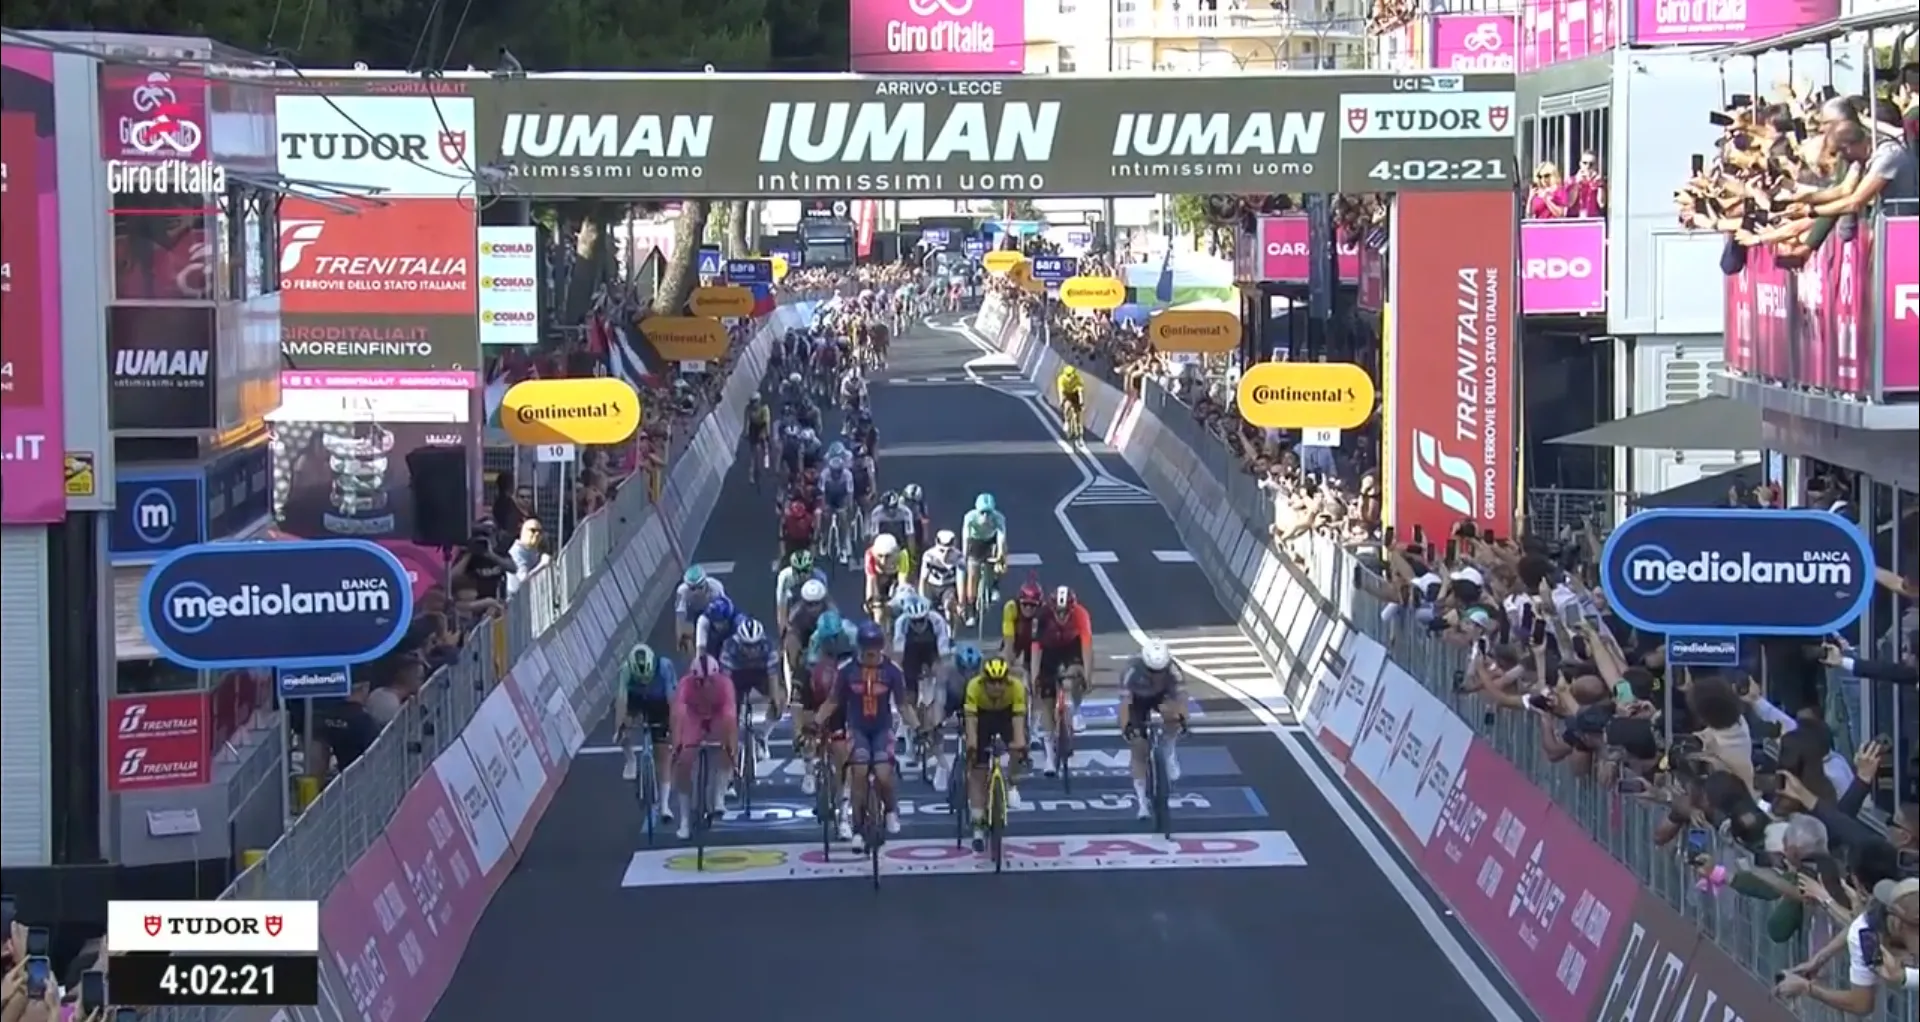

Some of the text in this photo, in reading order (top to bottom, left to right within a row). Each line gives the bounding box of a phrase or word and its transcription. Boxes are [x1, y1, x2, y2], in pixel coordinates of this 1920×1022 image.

[888, 20, 994, 52] Giro d'Italia
[876, 81, 938, 95] ARRIVO
[949, 81, 1002, 95] LECCE
[1393, 78, 1418, 90] UCI
[1375, 109, 1481, 130] TUDOR
[502, 113, 714, 158] IUMAN
[758, 101, 1061, 162] IUMAN
[1112, 112, 1325, 156] IUMAN
[281, 133, 428, 160] TUDOR
[643, 165, 703, 178] uomo
[1112, 162, 1314, 177] intimissimi uomo
[1368, 159, 1507, 180] 4:02:21
[758, 173, 1044, 191] intimissimi uomo
[315, 257, 467, 275] TRENITALIA
[294, 279, 344, 290] FERROVIE
[347, 279, 383, 290] DELLO
[384, 279, 417, 290] STATO
[419, 279, 467, 290] ITALIANE
[1160, 325, 1220, 338] Continental
[115, 350, 209, 376] IUMAN
[1457, 267, 1479, 440] TRENITALIA
[1252, 384, 1342, 404] Continental
[1484, 267, 1498, 519] GRUPPO FERROVIE DELLO STATO ITALIANE
[517, 402, 607, 424] Continental
[1317, 431, 1331, 441] 10
[549, 446, 564, 457] 10
[1803, 551, 1850, 562] BANCA
[1634, 551, 1851, 584] mediolanum
[342, 578, 388, 590] BANCA
[174, 583, 390, 618] mediolanum
[1673, 641, 1735, 653] mediolanum
[283, 672, 346, 687] mediolanum
